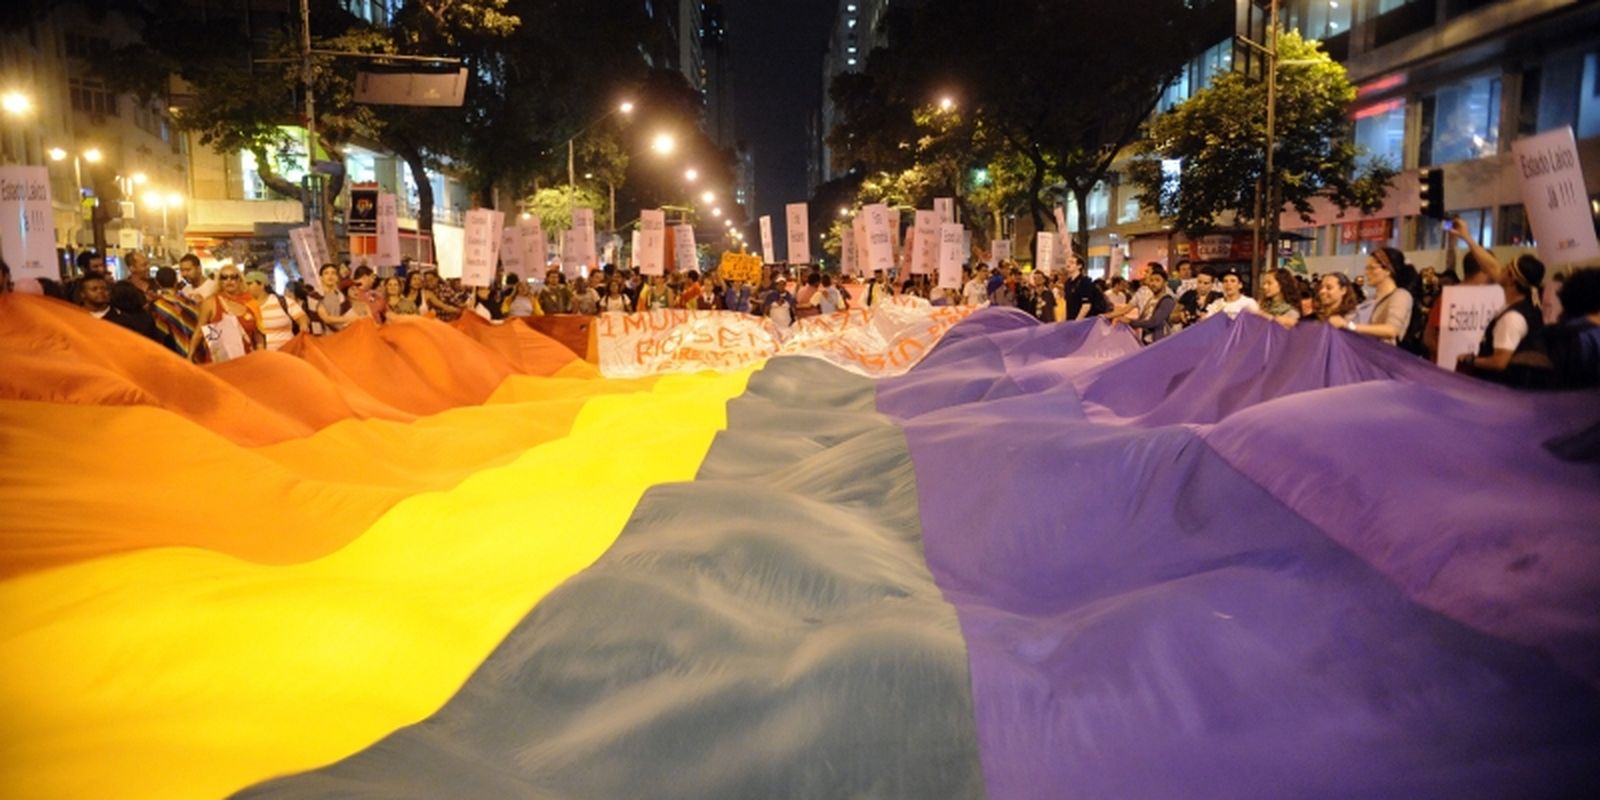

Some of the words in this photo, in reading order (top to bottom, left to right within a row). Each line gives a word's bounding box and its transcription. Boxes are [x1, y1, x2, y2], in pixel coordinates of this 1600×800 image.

[1520, 150, 1550, 179] Estado
[1547, 145, 1575, 172] Laico
[25, 178, 47, 201] Laico
[1448, 303, 1479, 331] Estado
